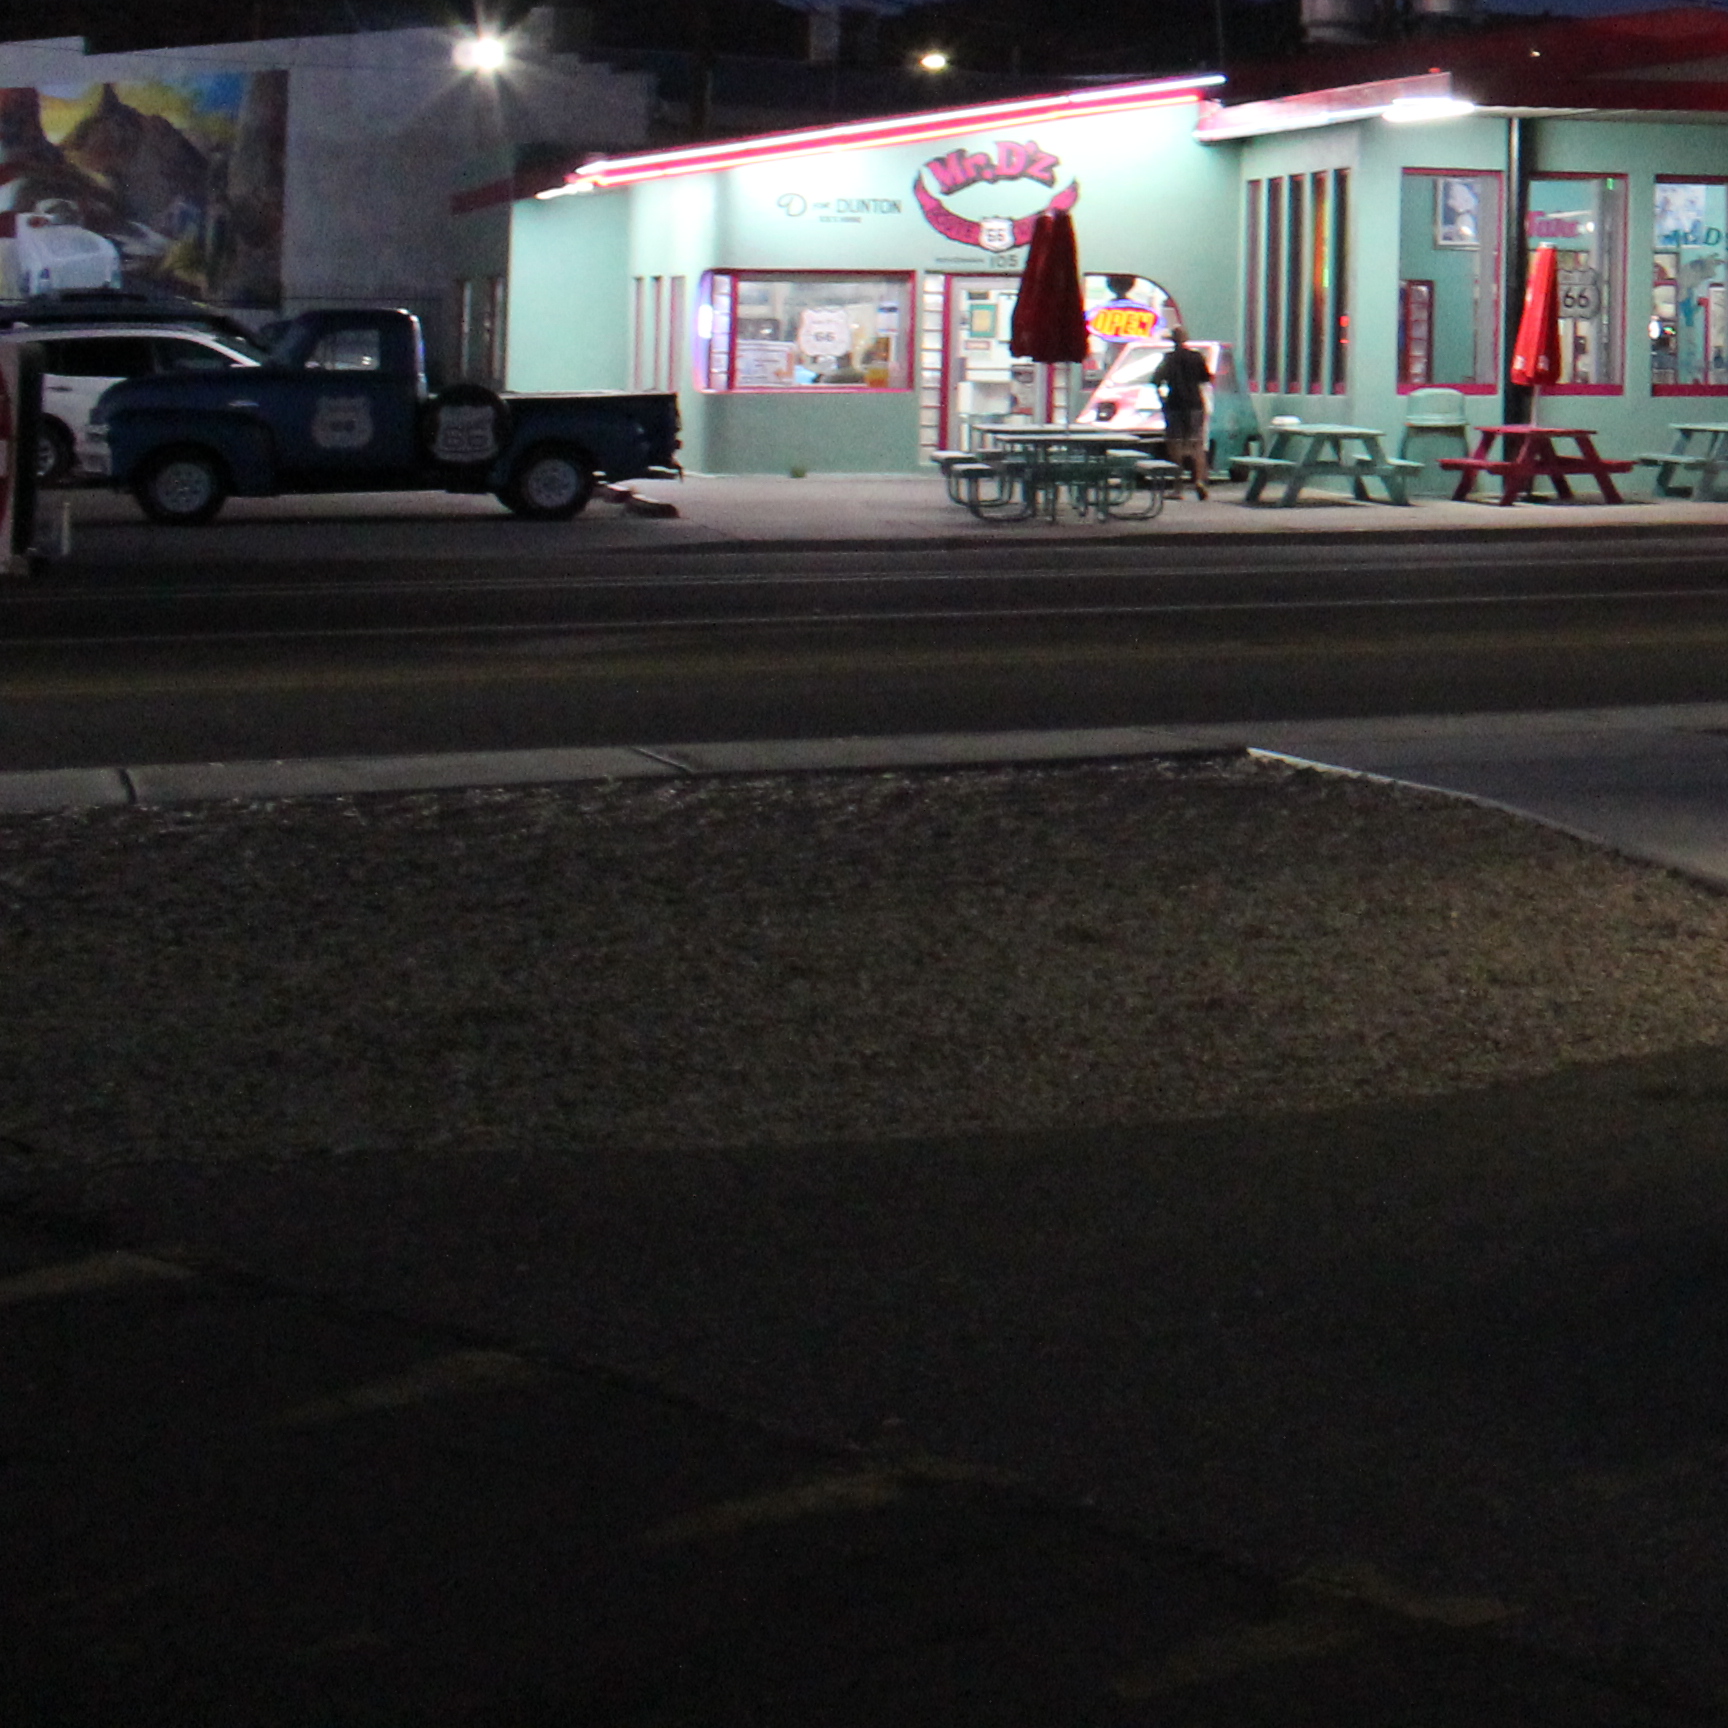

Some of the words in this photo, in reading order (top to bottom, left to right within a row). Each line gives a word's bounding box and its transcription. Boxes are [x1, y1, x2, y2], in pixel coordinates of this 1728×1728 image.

[926, 148, 995, 195] Mr.
[994, 140, 1060, 188] D'z
[836, 198, 902, 214] DUNTON
[1562, 289, 1589, 308] 66
[1092, 309, 1156, 336] OPEN
